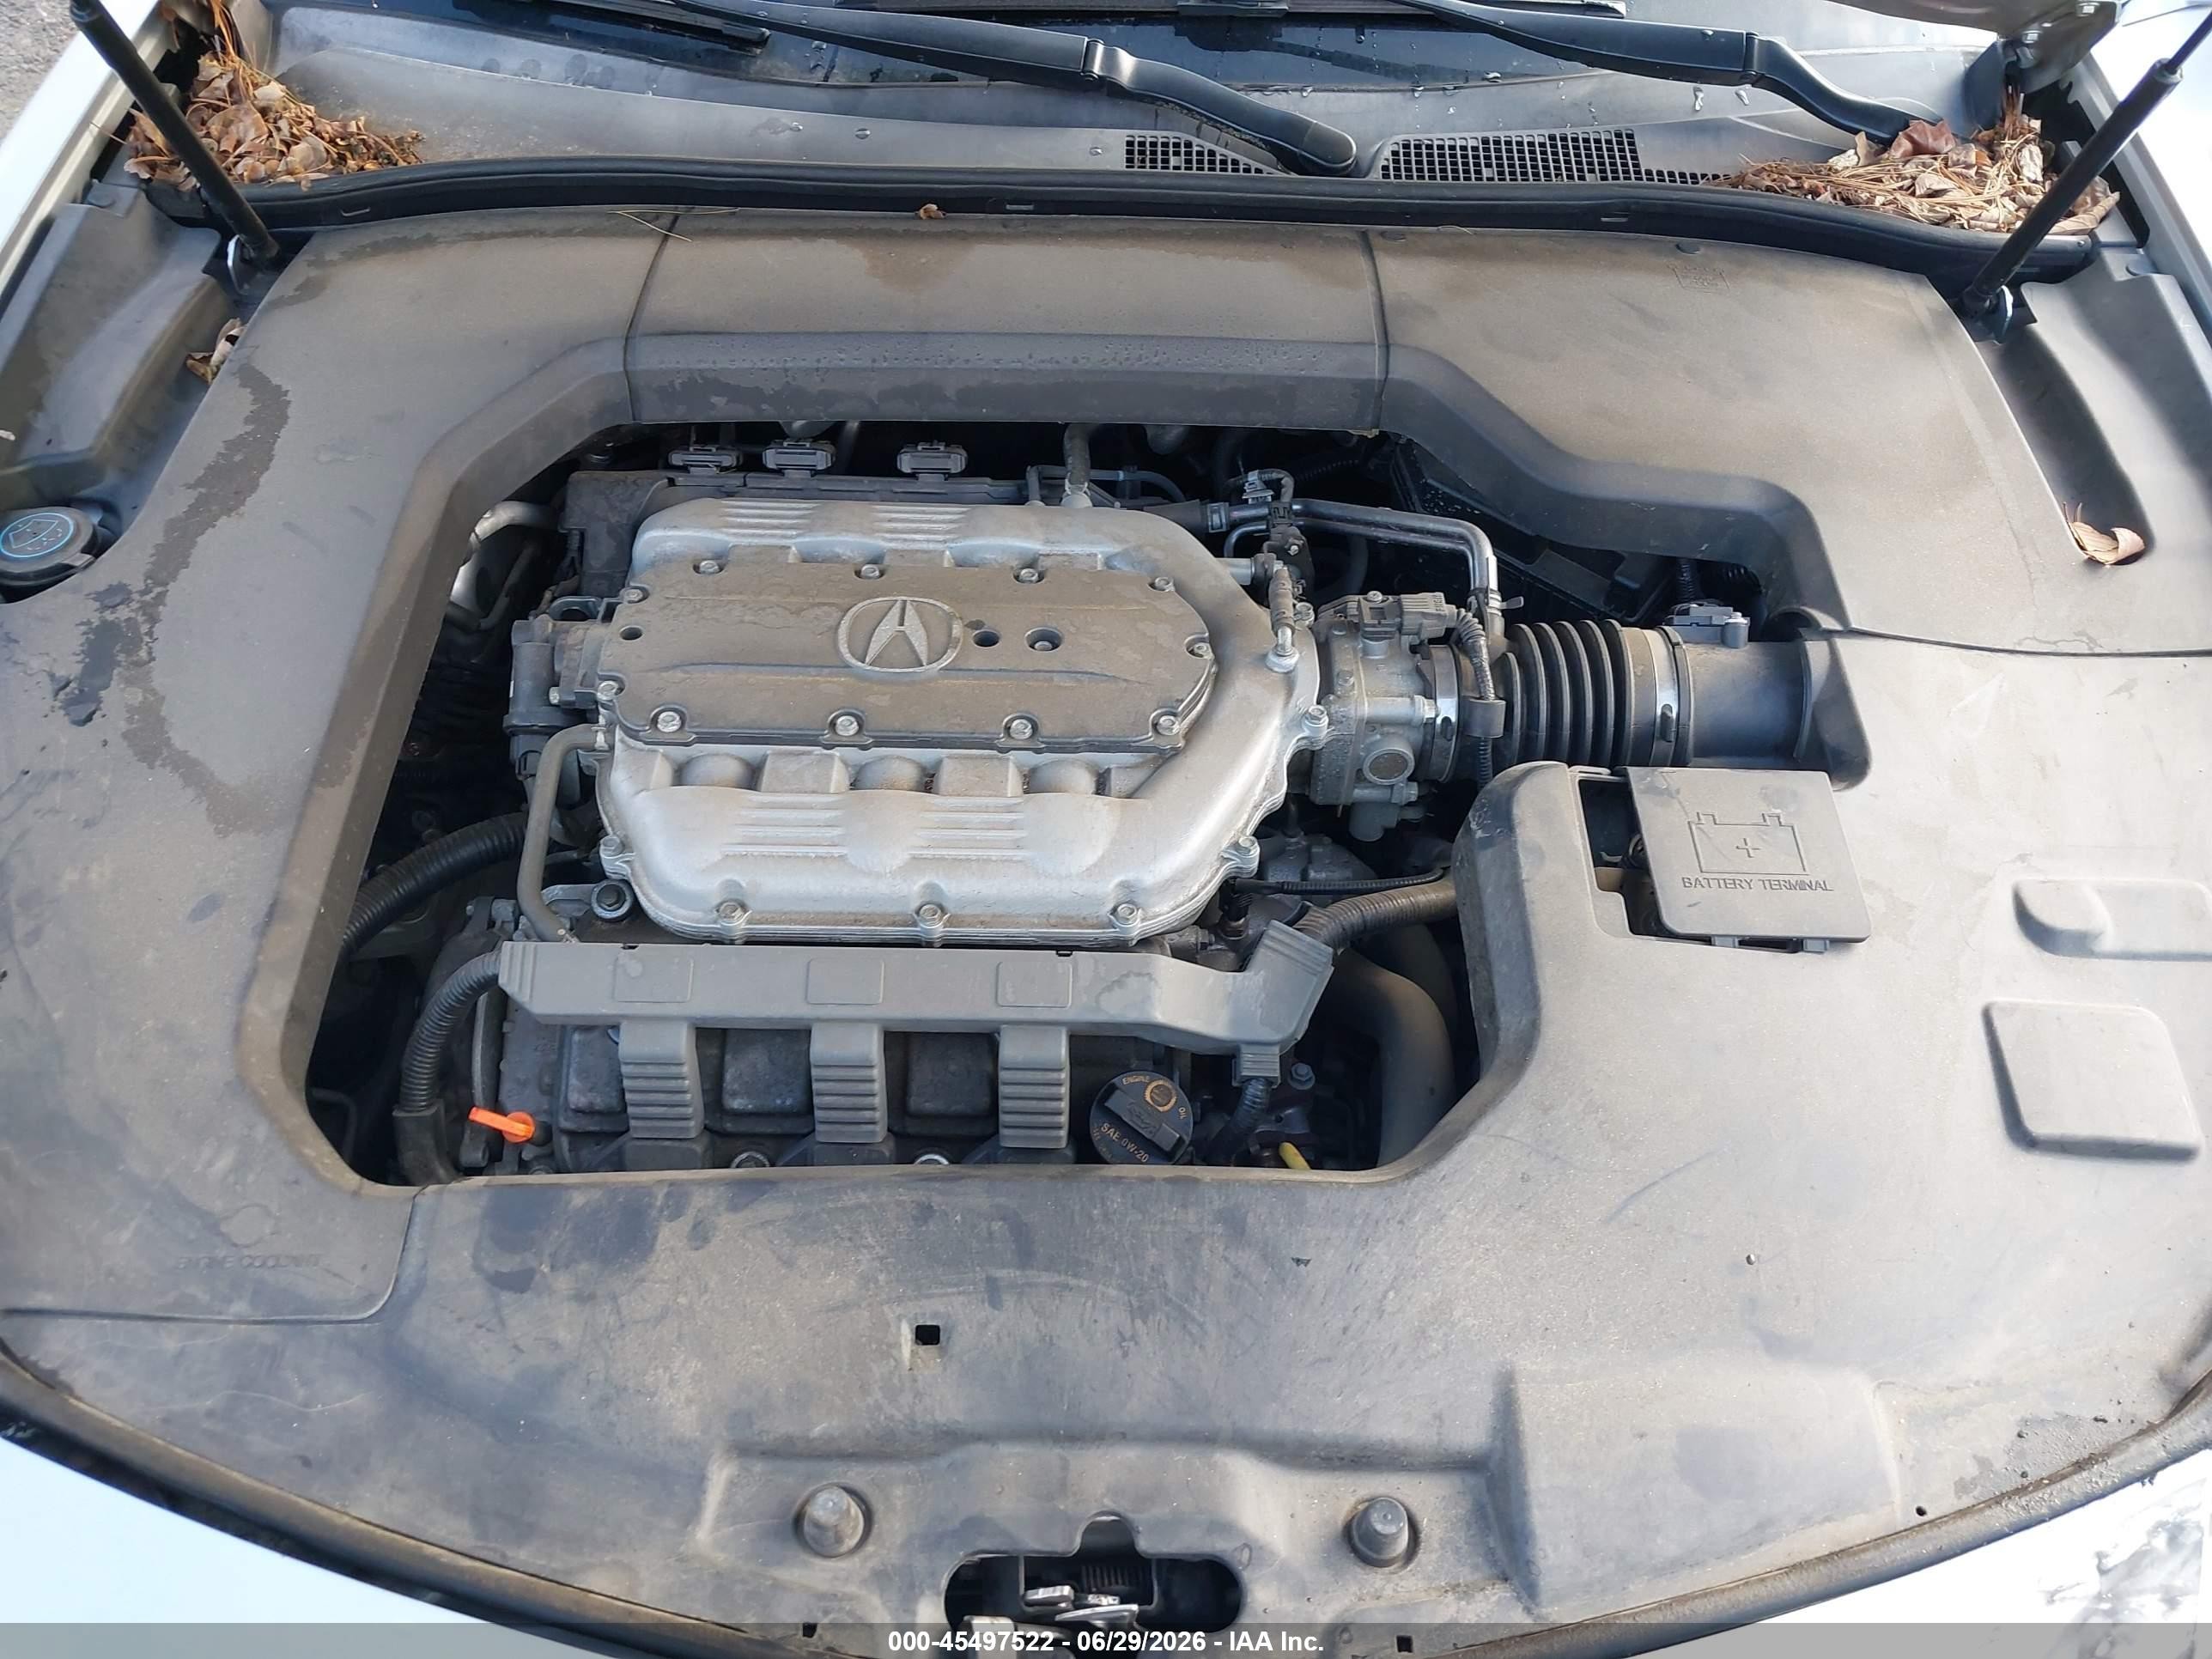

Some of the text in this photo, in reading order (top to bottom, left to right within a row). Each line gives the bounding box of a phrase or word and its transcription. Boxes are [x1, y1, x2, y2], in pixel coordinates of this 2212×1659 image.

[1681, 877, 1834, 891] BATTERY TERMINAL
[1178, 1107, 1188, 1120] OIL
[1100, 1122, 1121, 1142] SAE
[1121, 1138, 1149, 1163] 0W-20
